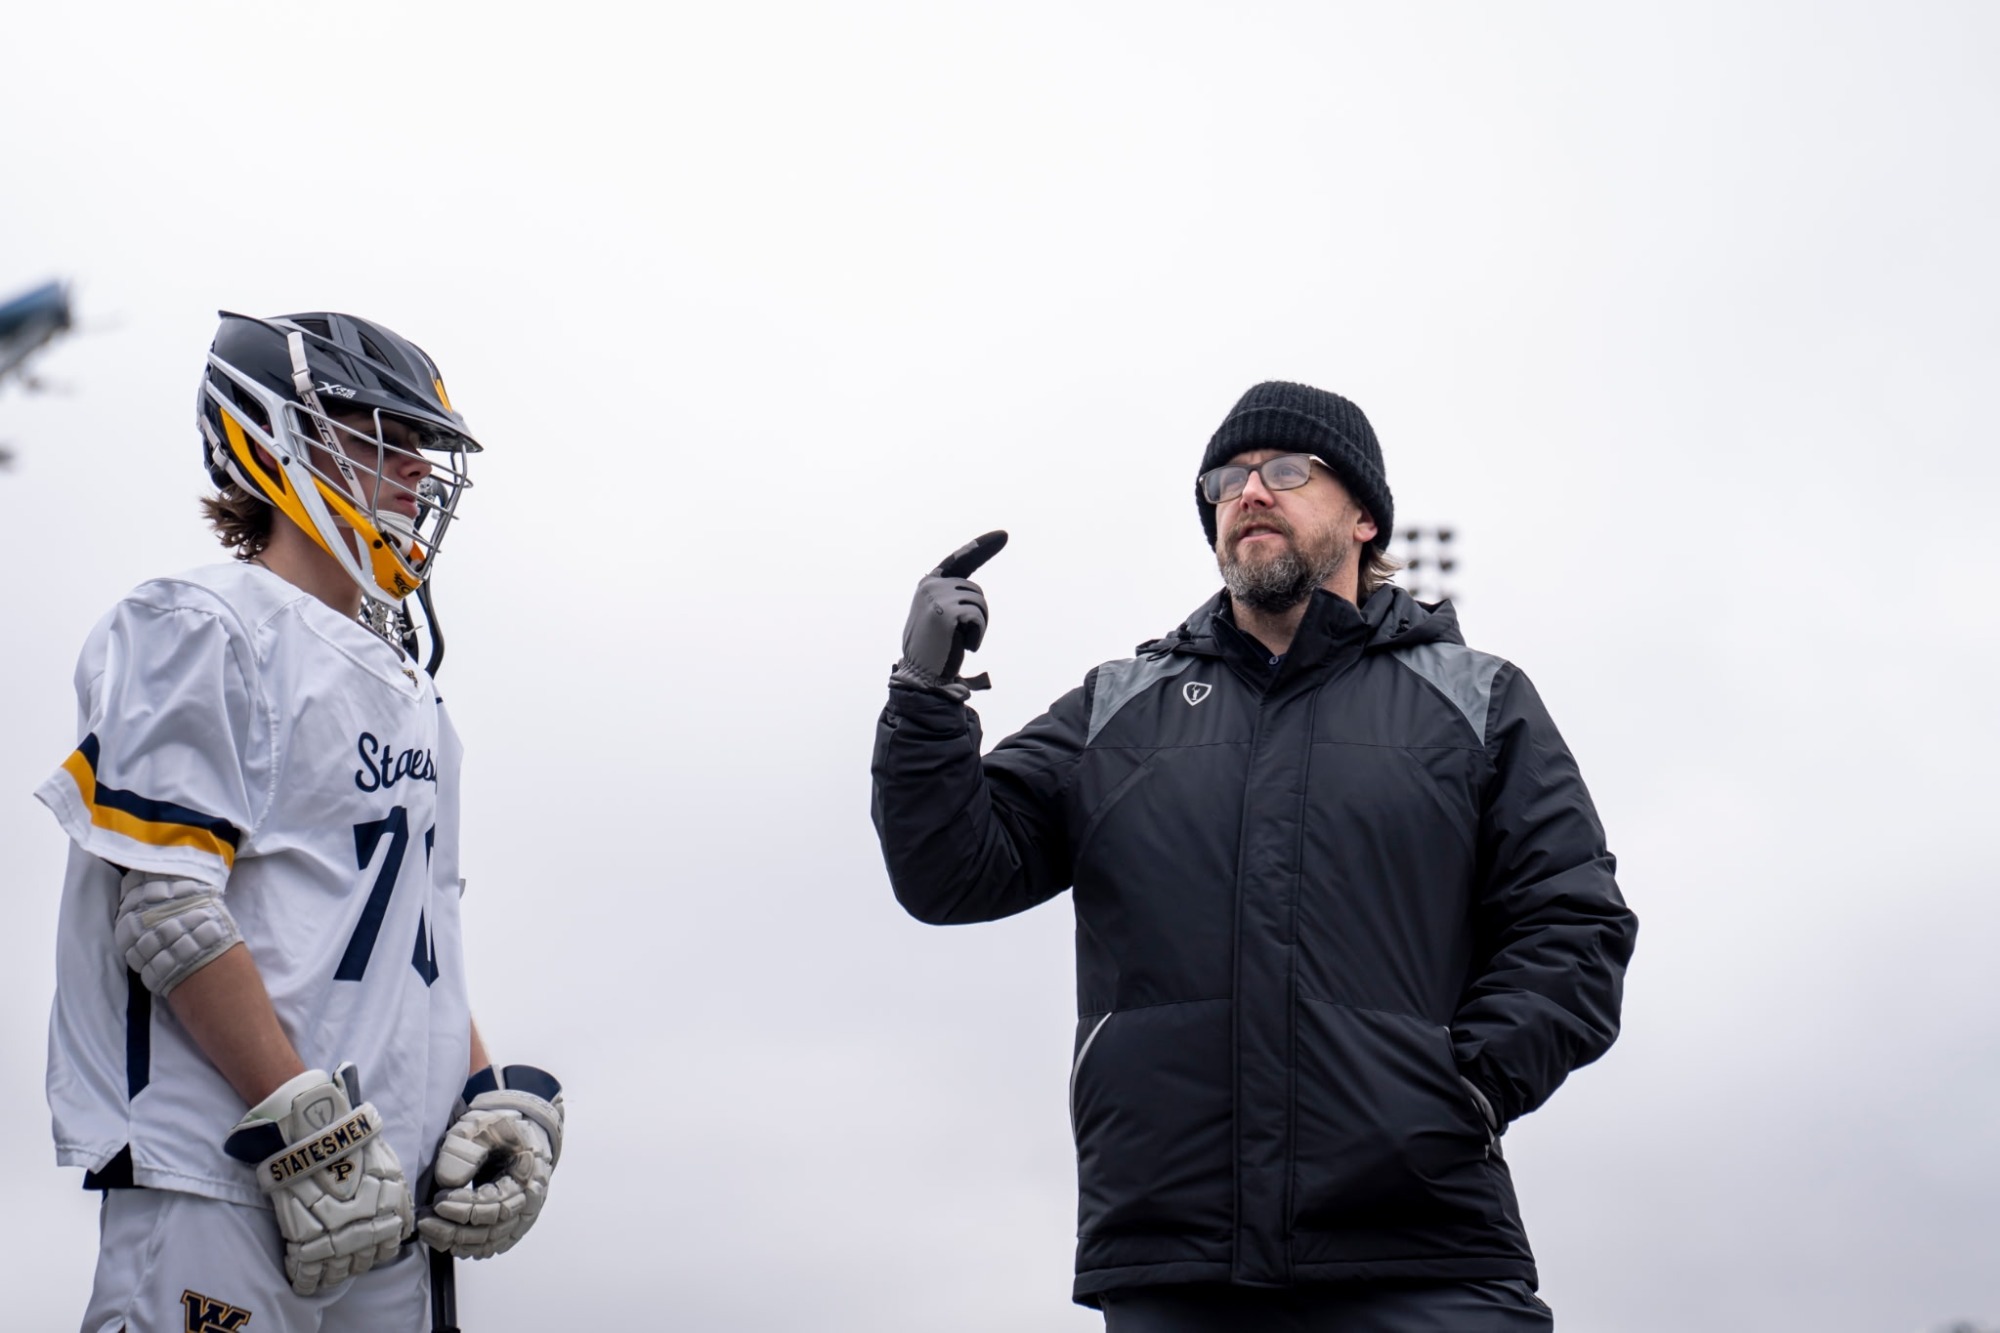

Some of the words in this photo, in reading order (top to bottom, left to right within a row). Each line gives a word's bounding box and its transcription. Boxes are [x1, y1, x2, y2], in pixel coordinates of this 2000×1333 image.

[268, 1112, 374, 1183] STATESMEN
[327, 1157, 355, 1183] P
[180, 1289, 252, 1333] W
